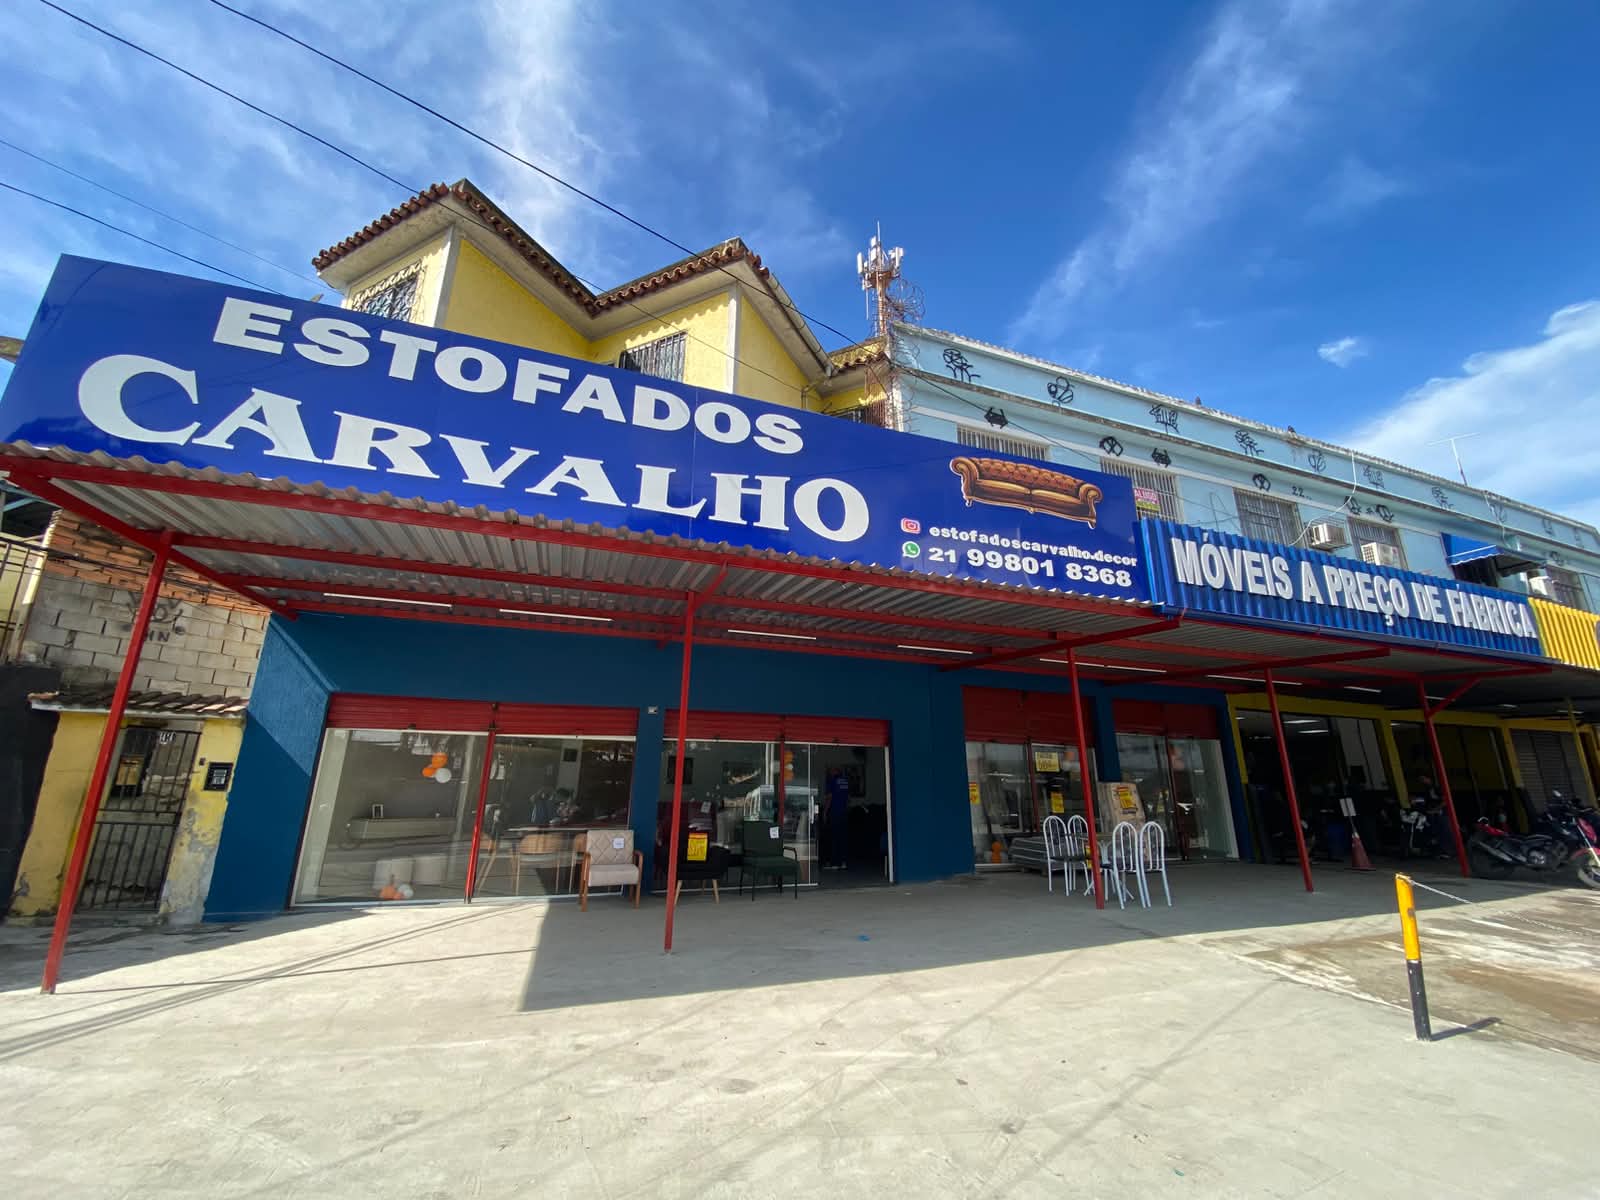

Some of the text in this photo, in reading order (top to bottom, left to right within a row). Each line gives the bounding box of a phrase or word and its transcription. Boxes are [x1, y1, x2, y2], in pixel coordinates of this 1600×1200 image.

[213, 297, 803, 454] ESTOFADOS
[78, 354, 869, 542] CARVALHO
[928, 547, 1132, 588] 21 99801 8368
[929, 526, 1137, 567] estofadoscarvalho.decor
[1171, 532, 1538, 639] MÓVEIS A PREÇO DE FÁBRICA
